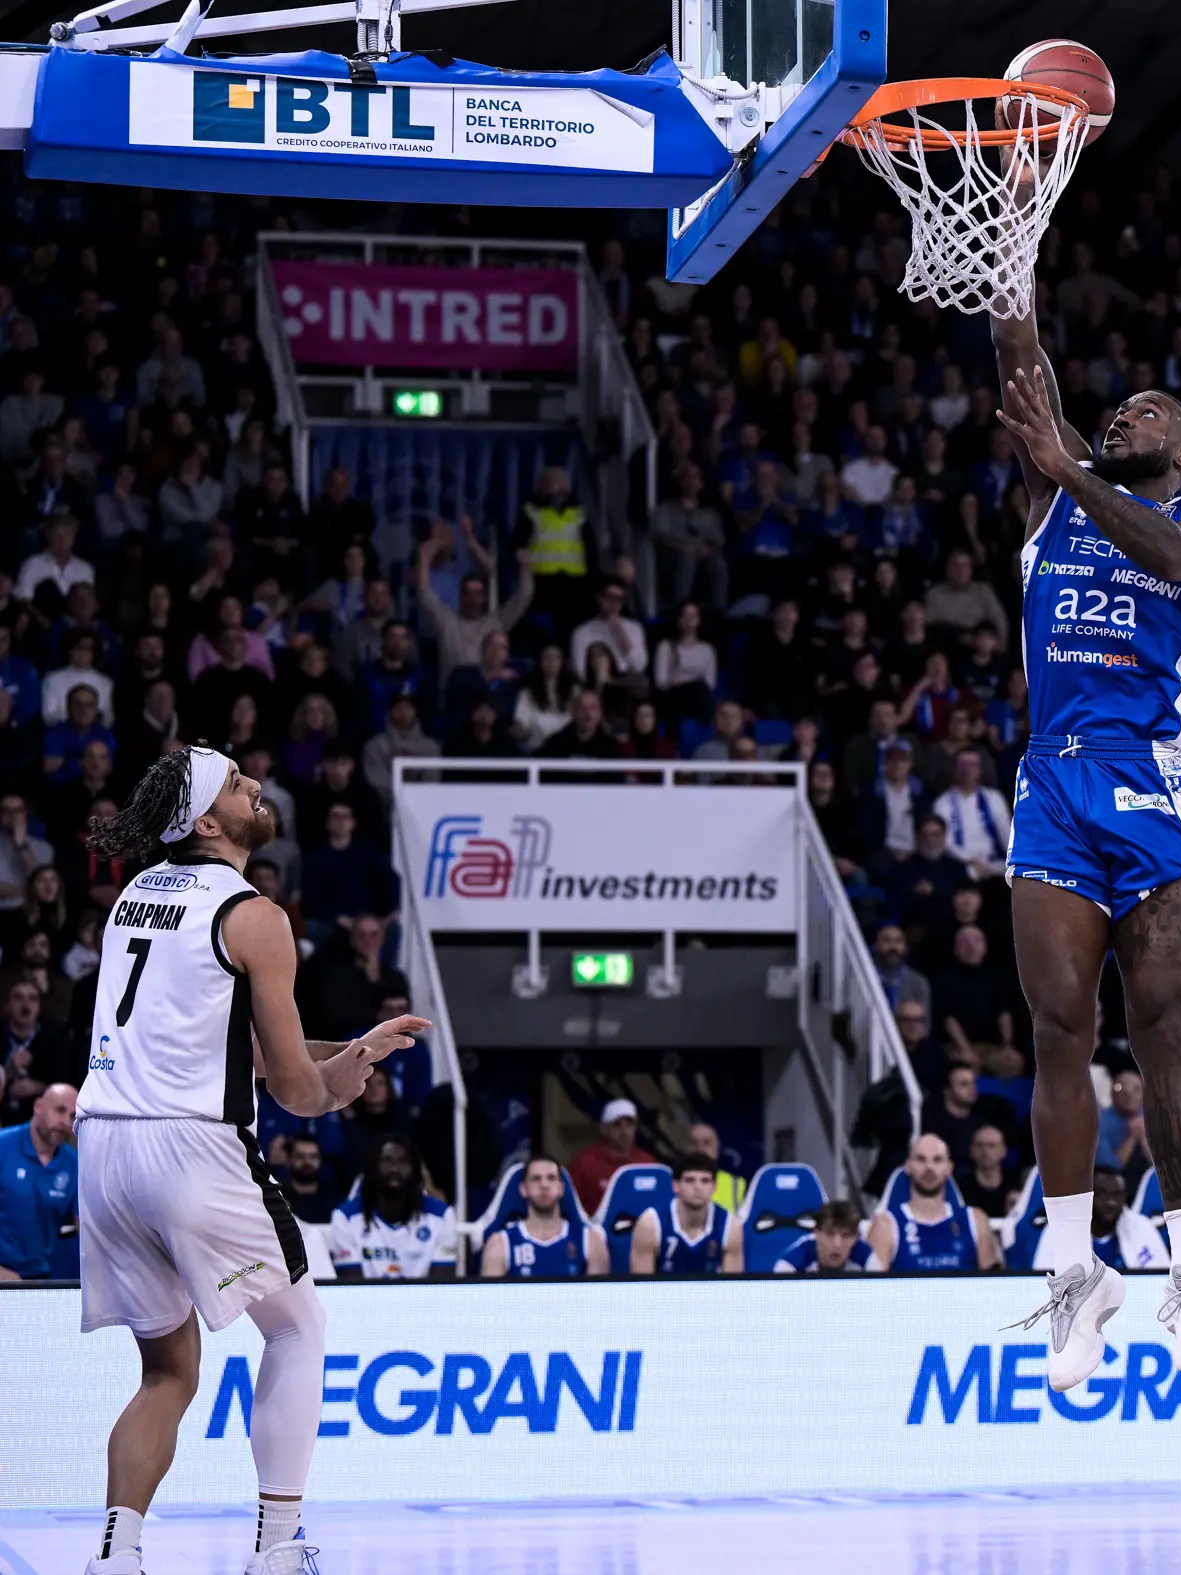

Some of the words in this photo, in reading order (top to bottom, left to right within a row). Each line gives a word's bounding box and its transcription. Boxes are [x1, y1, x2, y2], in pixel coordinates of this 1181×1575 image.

[276, 76, 435, 141] BTL
[466, 97, 522, 112] BANCA
[466, 115, 496, 127] DEL
[500, 116, 595, 134] TERRITORIO
[276, 137, 317, 147] CREDITO
[320, 140, 387, 150] COOPERATIVO
[389, 143, 433, 153] ITALIANO
[466, 132, 557, 148] LOMBARDO
[328, 287, 567, 344] INTRED
[1069, 535, 1127, 560] TECH
[1111, 569, 1181, 600] MEGRANI
[1054, 588, 1136, 628] a2a
[1051, 624, 1072, 634] LIFE
[1075, 625, 1135, 641] COMPANY
[1046, 642, 1138, 667] Humangest
[141, 874, 191, 889] GIUDICI
[541, 867, 778, 901] investments
[114, 900, 187, 930] CHAPMAN
[116, 937, 152, 1027] 7
[89, 1054, 116, 1071] Costa
